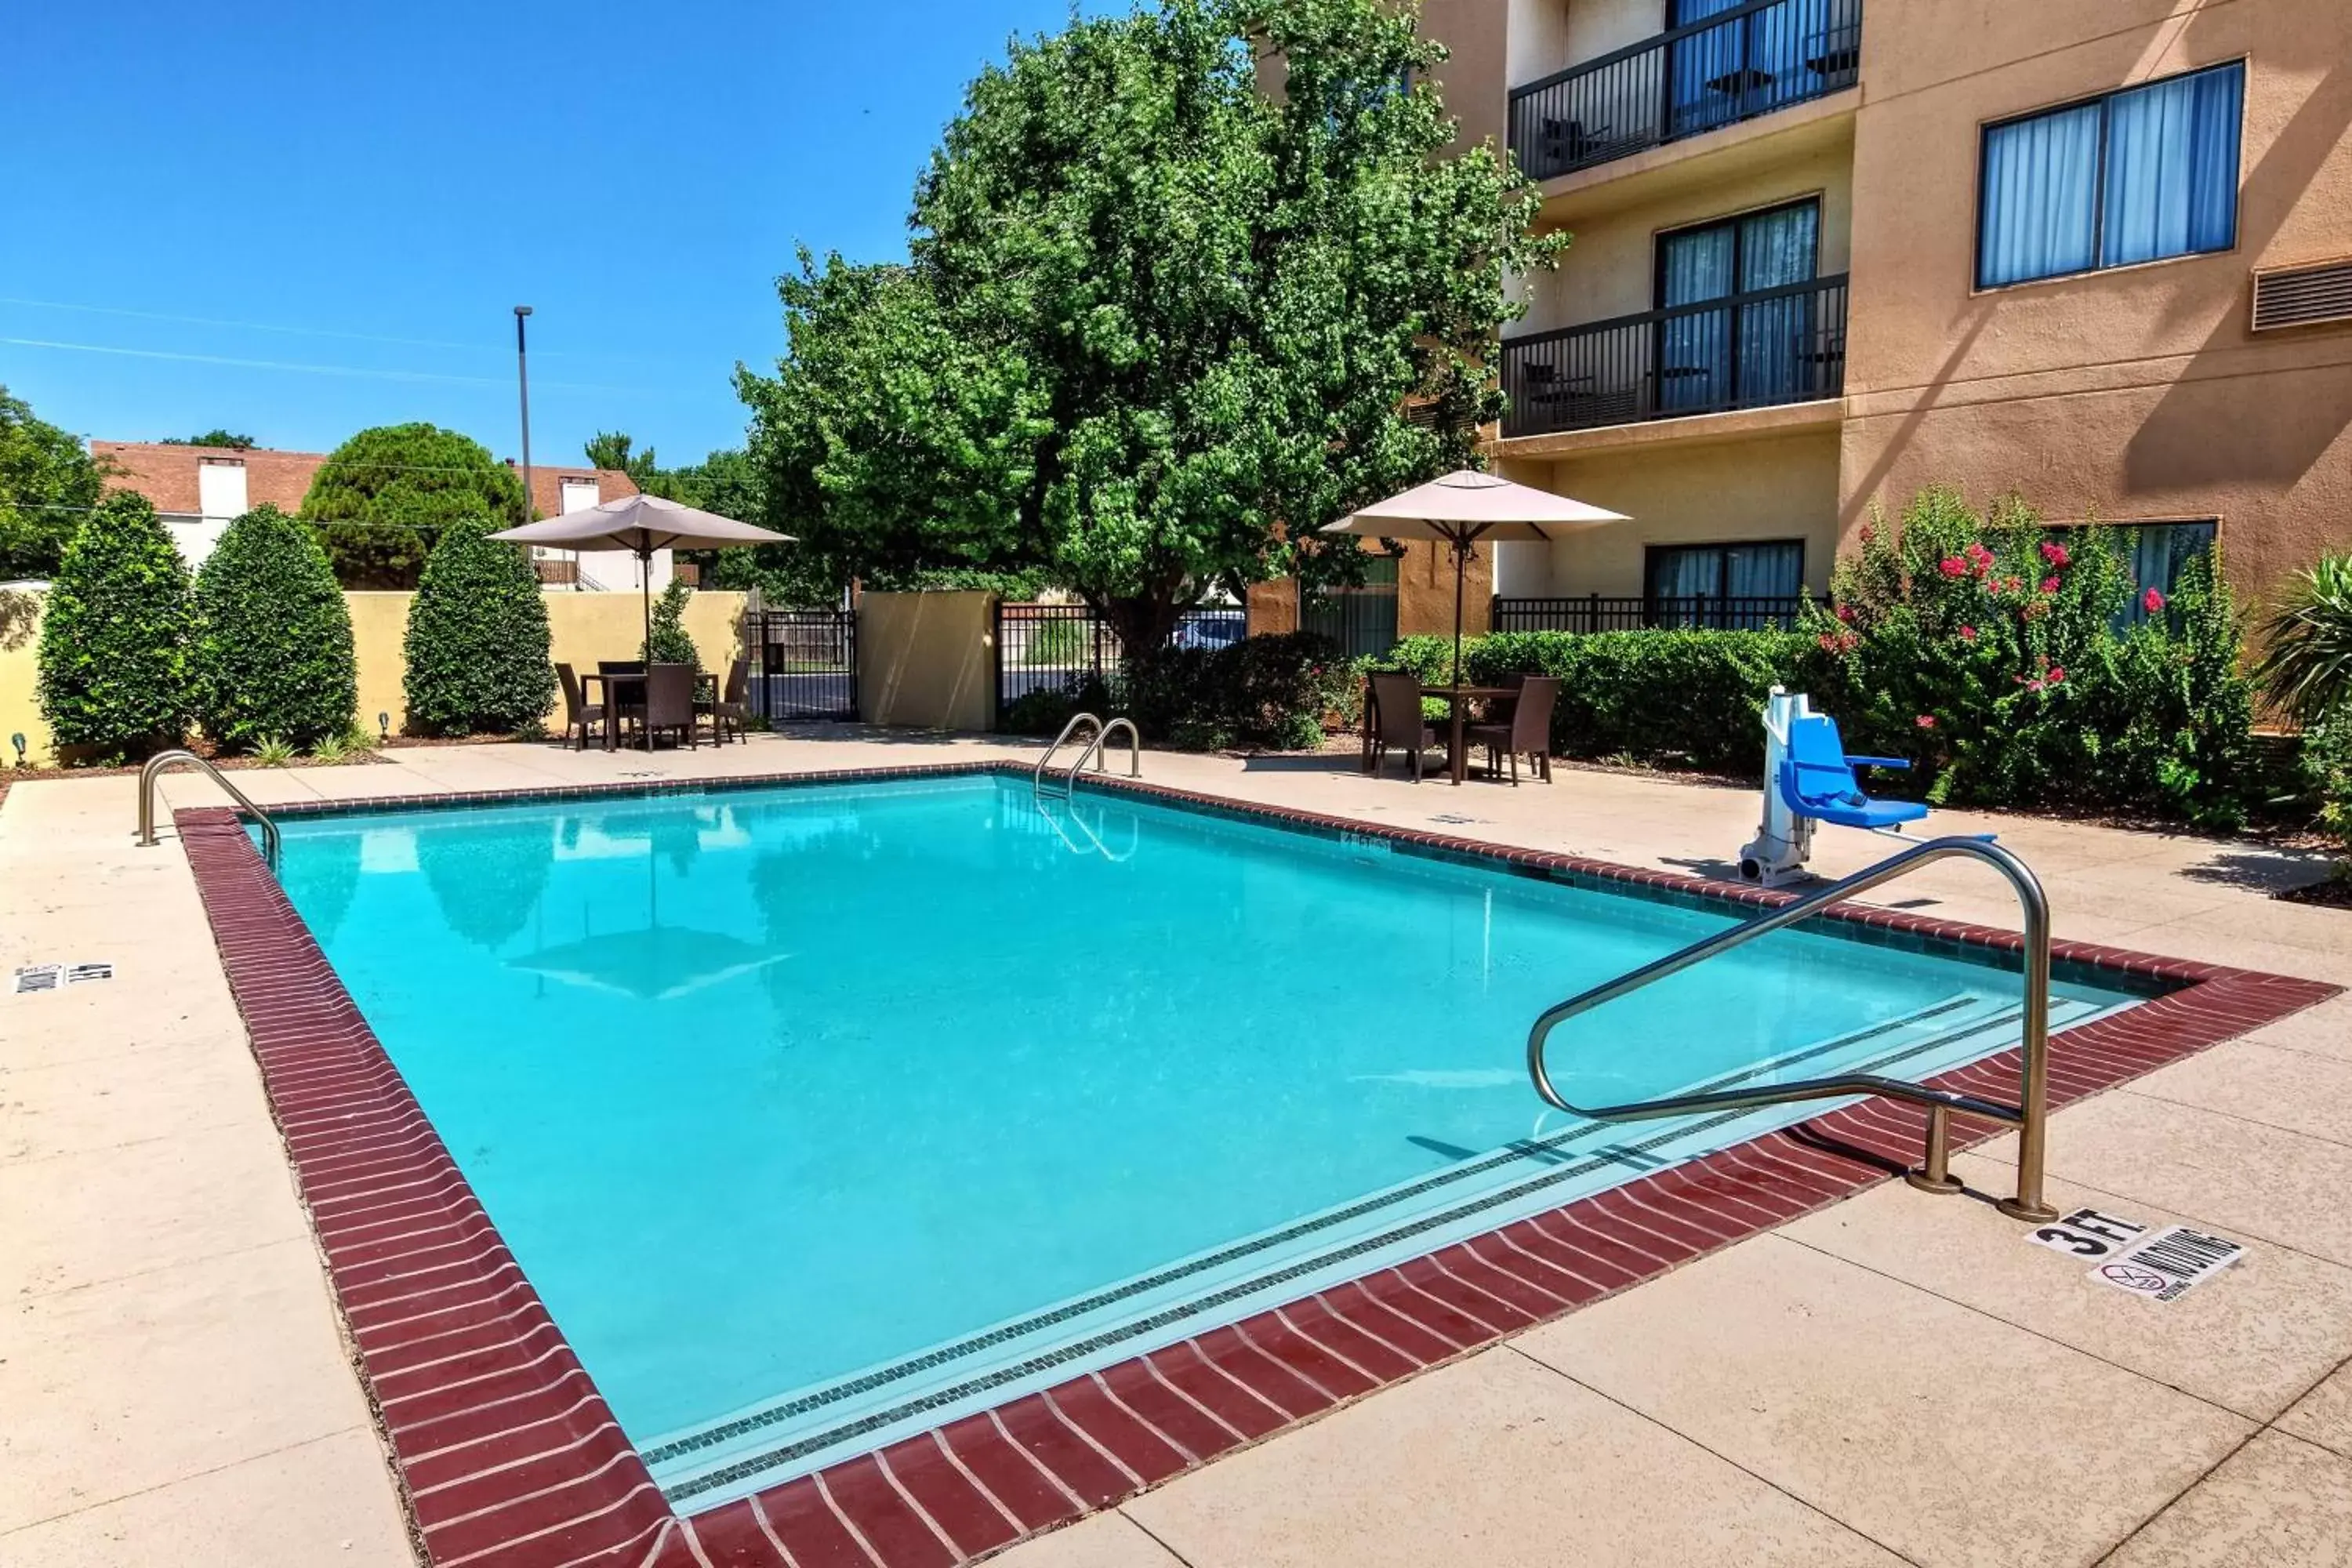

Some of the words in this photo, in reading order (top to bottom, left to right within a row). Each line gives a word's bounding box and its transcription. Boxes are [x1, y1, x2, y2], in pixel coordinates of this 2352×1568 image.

[2036, 1228, 2108, 1255] 3
[2146, 1229, 2242, 1269] DIVING
[2128, 1251, 2199, 1279] NO
